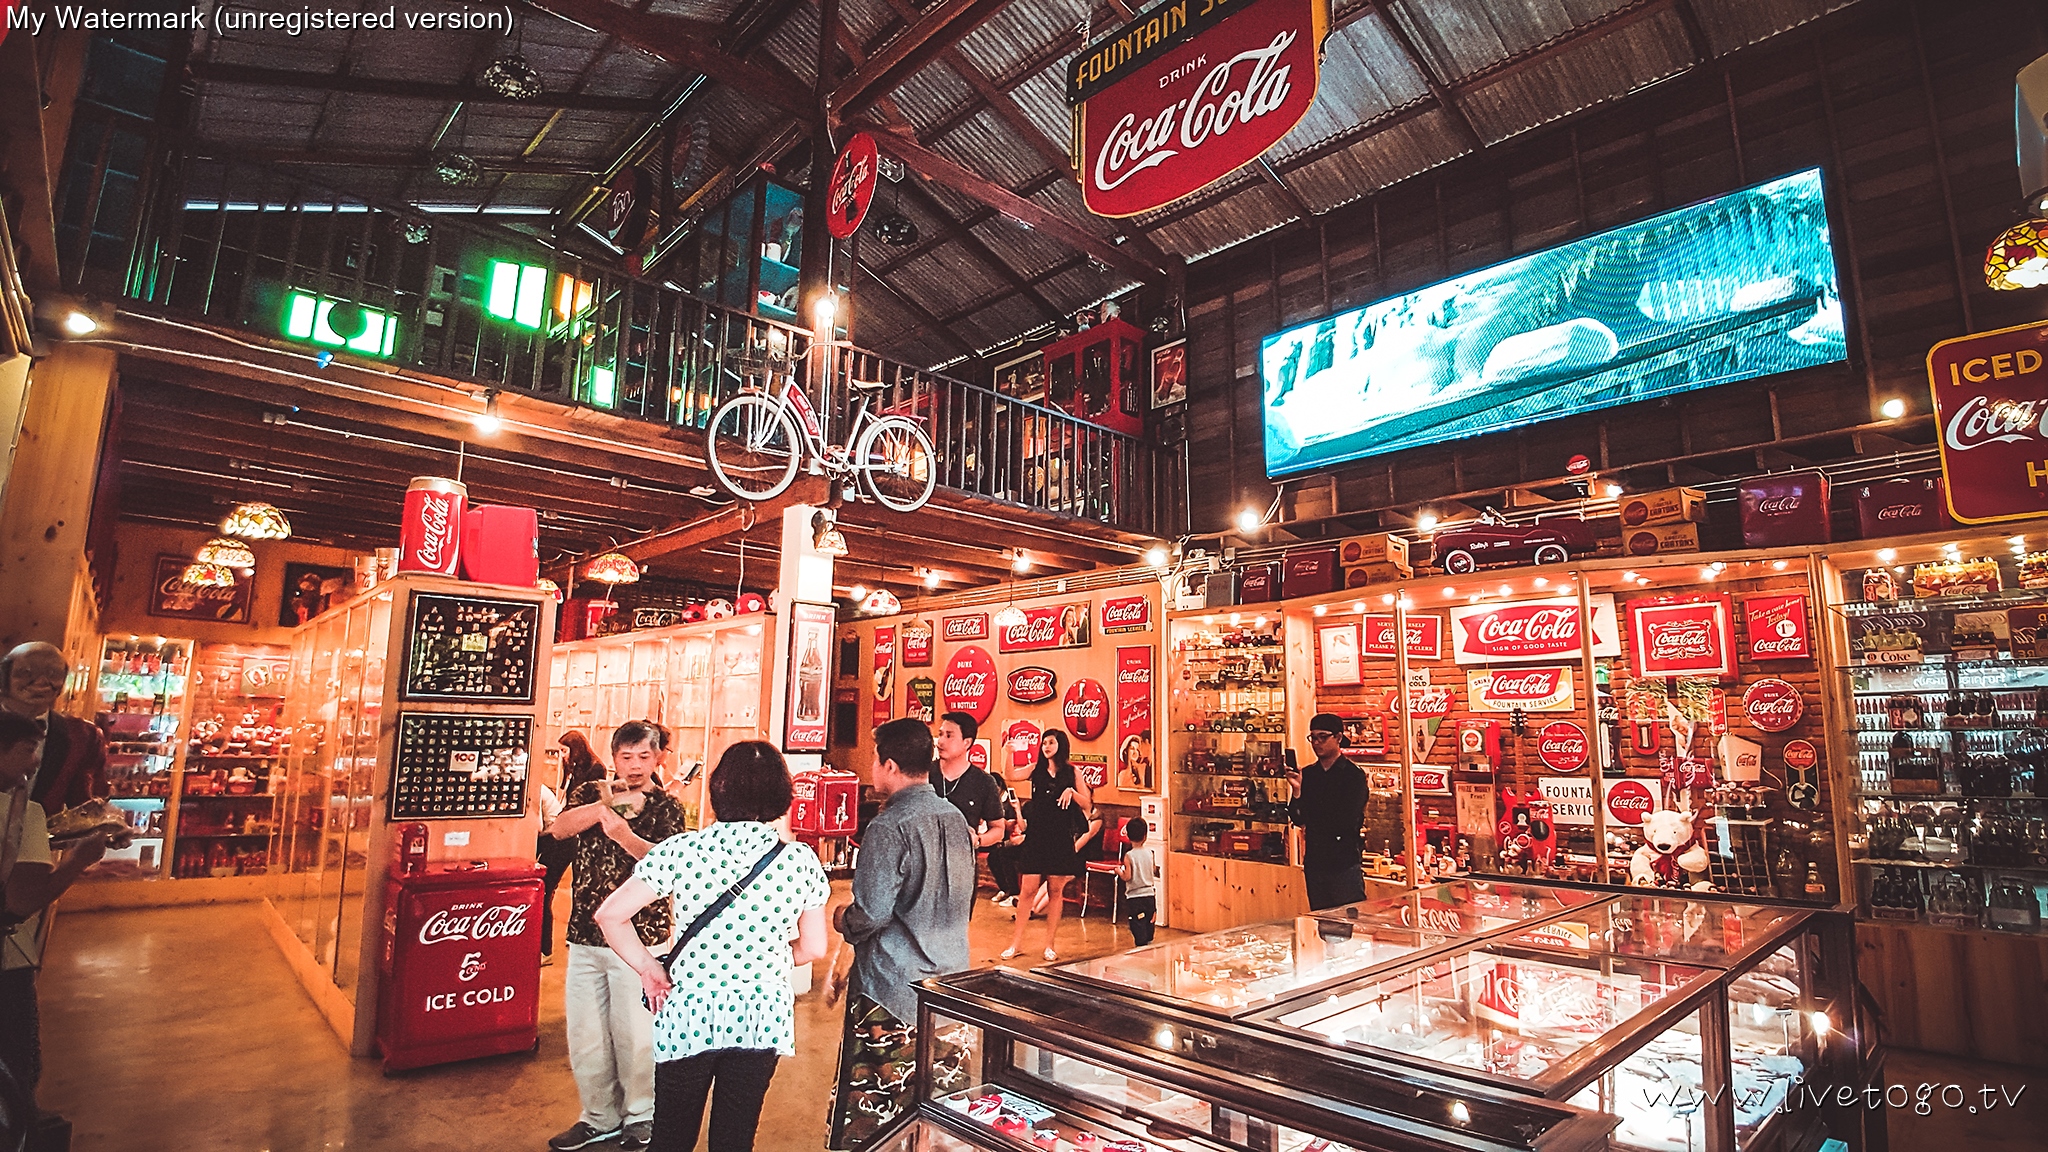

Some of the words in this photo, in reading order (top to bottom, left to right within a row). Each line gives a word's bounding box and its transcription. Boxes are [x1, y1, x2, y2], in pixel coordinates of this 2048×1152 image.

[1075, 5, 1187, 90] FOUNTAIN
[1159, 53, 1207, 89] DRINK
[1094, 28, 1298, 191] Coca-Cola
[1949, 349, 2044, 387] ICED
[1945, 396, 2048, 451] Coca-
[417, 492, 450, 570] Coca-Cola
[1477, 608, 1578, 644] Coca-Cola
[1655, 629, 1707, 647] Coca-Cola
[1753, 637, 1802, 653] Coca-Cola
[1881, 651, 1911, 663] Coke
[944, 672, 988, 697] Coca-Cola
[1492, 673, 1553, 695] Coca-Cola
[1064, 699, 1101, 718] Coca-Cola
[1528, 695, 1558, 708] SERVICE
[1541, 739, 1584, 753] Coca-Cola
[1611, 795, 1650, 809] Coca-Cola
[451, 902, 485, 911] DRINK
[419, 903, 532, 945] Coca-Cola
[458, 951, 482, 982] 5
[425, 992, 457, 1012] ICE
[463, 985, 516, 1007] COLD
